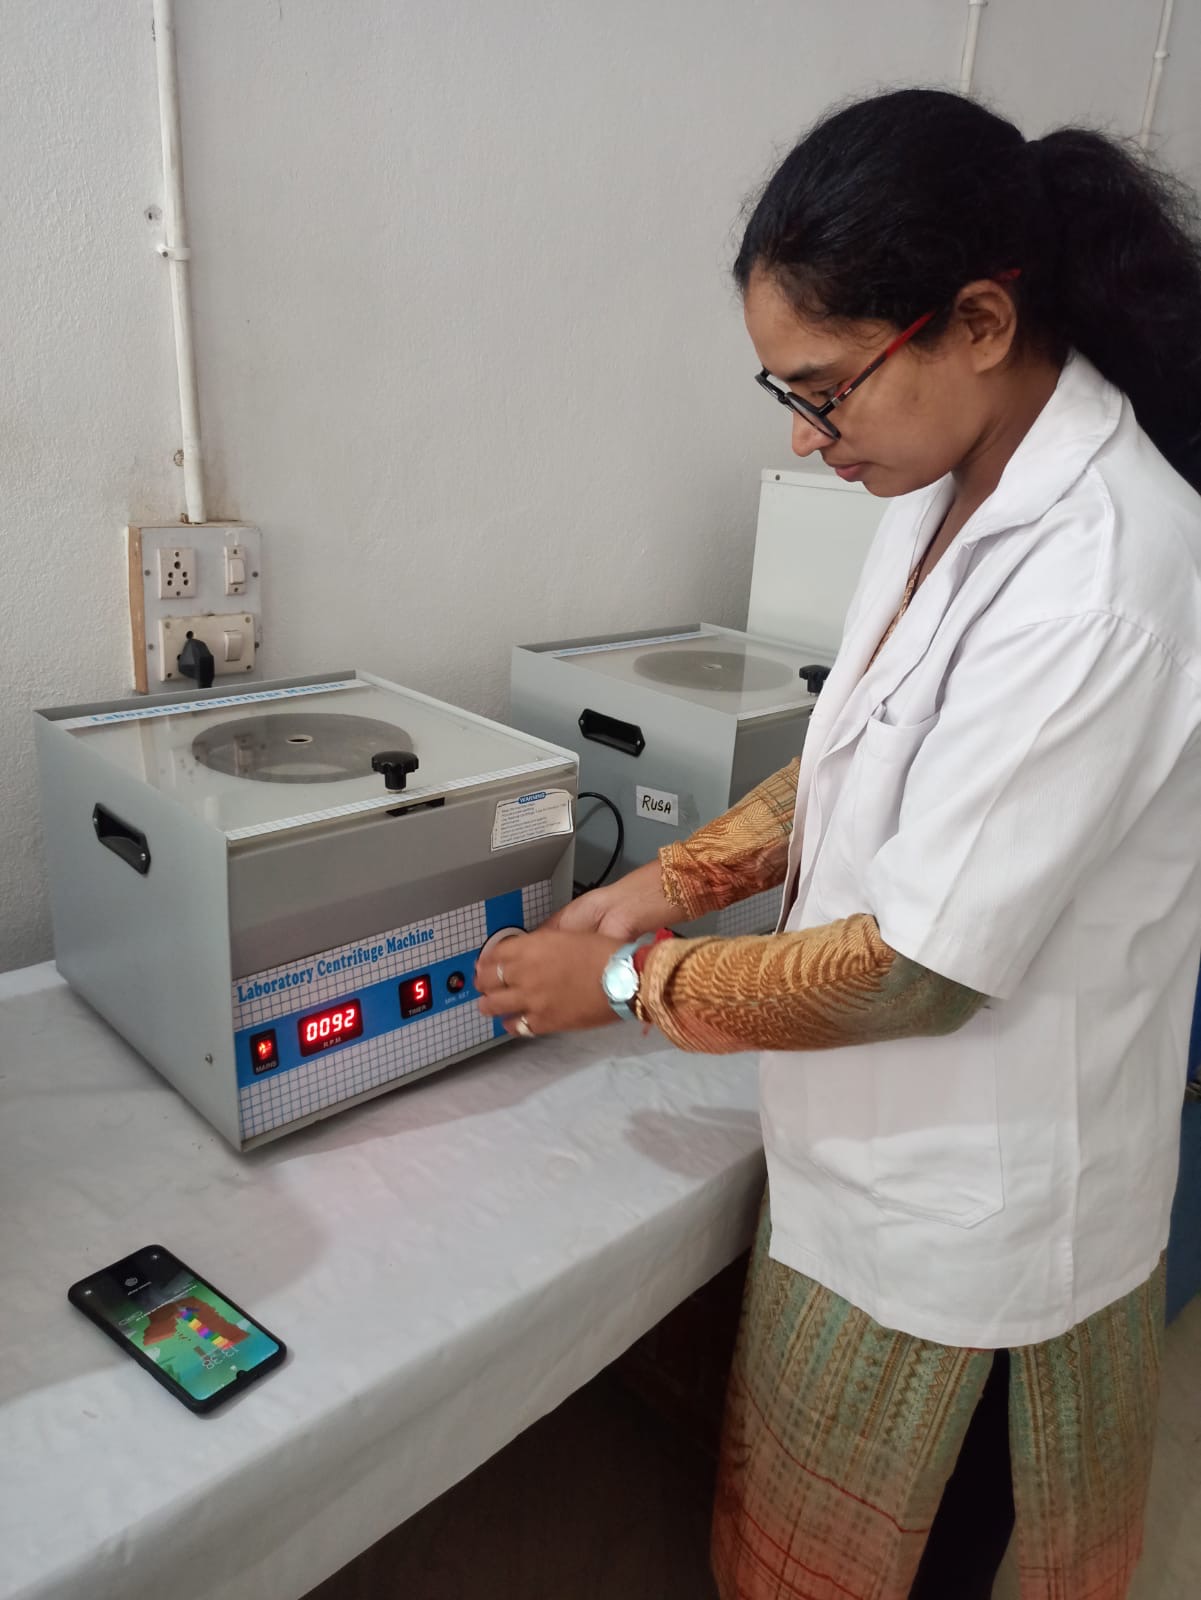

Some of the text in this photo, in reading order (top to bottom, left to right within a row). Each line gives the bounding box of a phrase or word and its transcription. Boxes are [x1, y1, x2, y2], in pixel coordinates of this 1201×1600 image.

[91, 682, 346, 722] Laboratory Centrifuge Machine
[642, 795, 671, 814] RUSA
[237, 928, 434, 1003] Laboratory Centrifuge Machine
[415, 981, 425, 1000] 5
[408, 1004, 427, 1016] TIMER
[306, 1008, 355, 1042] 0092
[255, 1060, 278, 1073] MAINS
